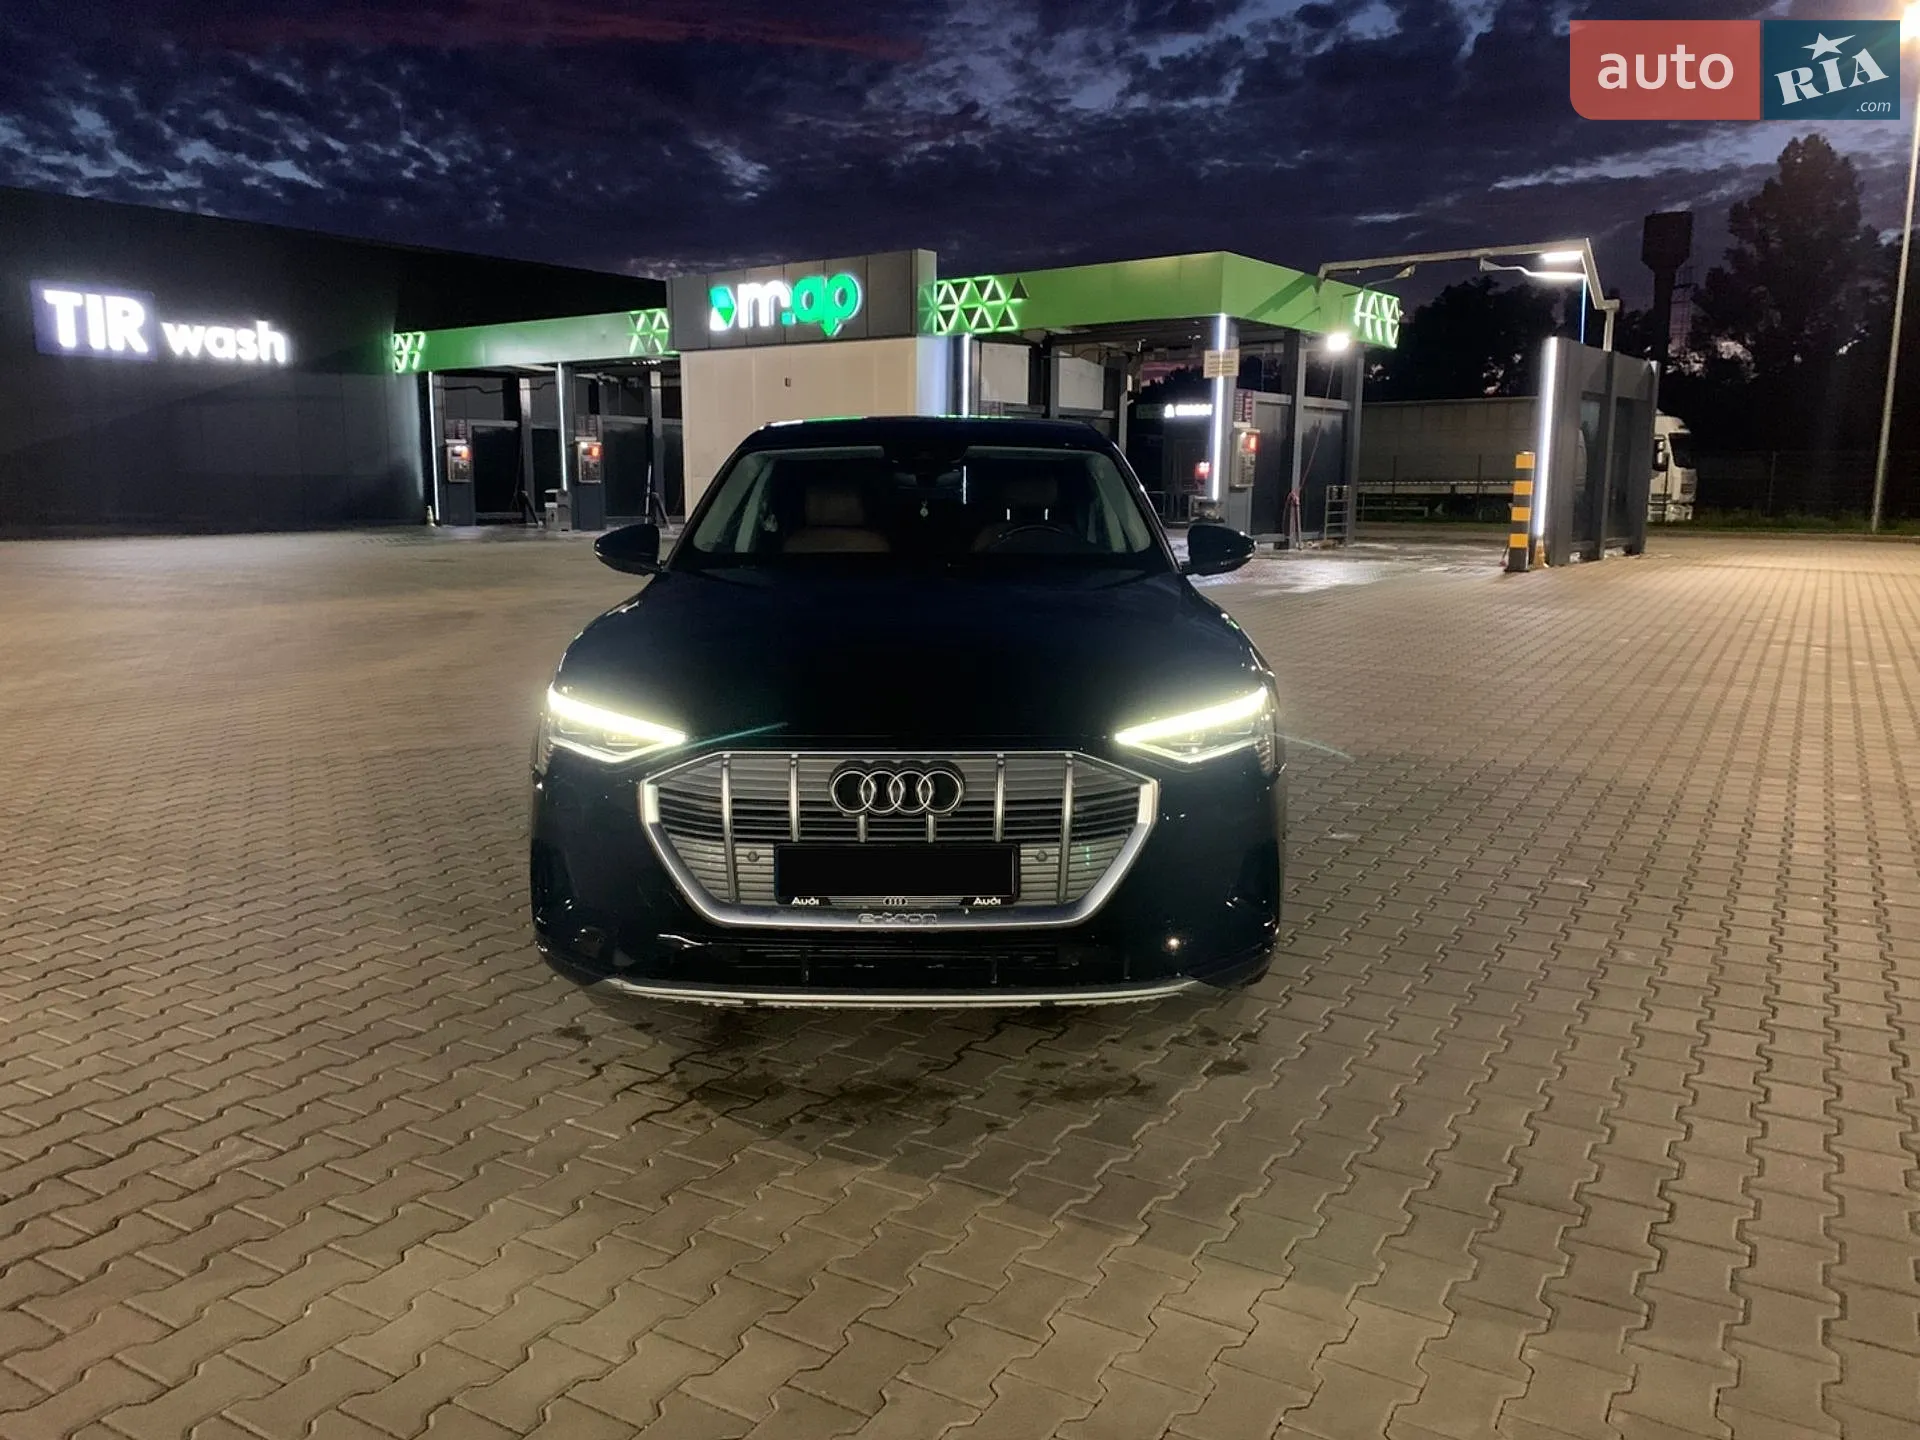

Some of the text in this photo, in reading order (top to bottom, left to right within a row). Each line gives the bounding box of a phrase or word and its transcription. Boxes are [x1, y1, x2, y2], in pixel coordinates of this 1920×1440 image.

[42, 288, 289, 365] TIR wash
[791, 896, 820, 906] Audi
[973, 896, 1001, 906] Audi
